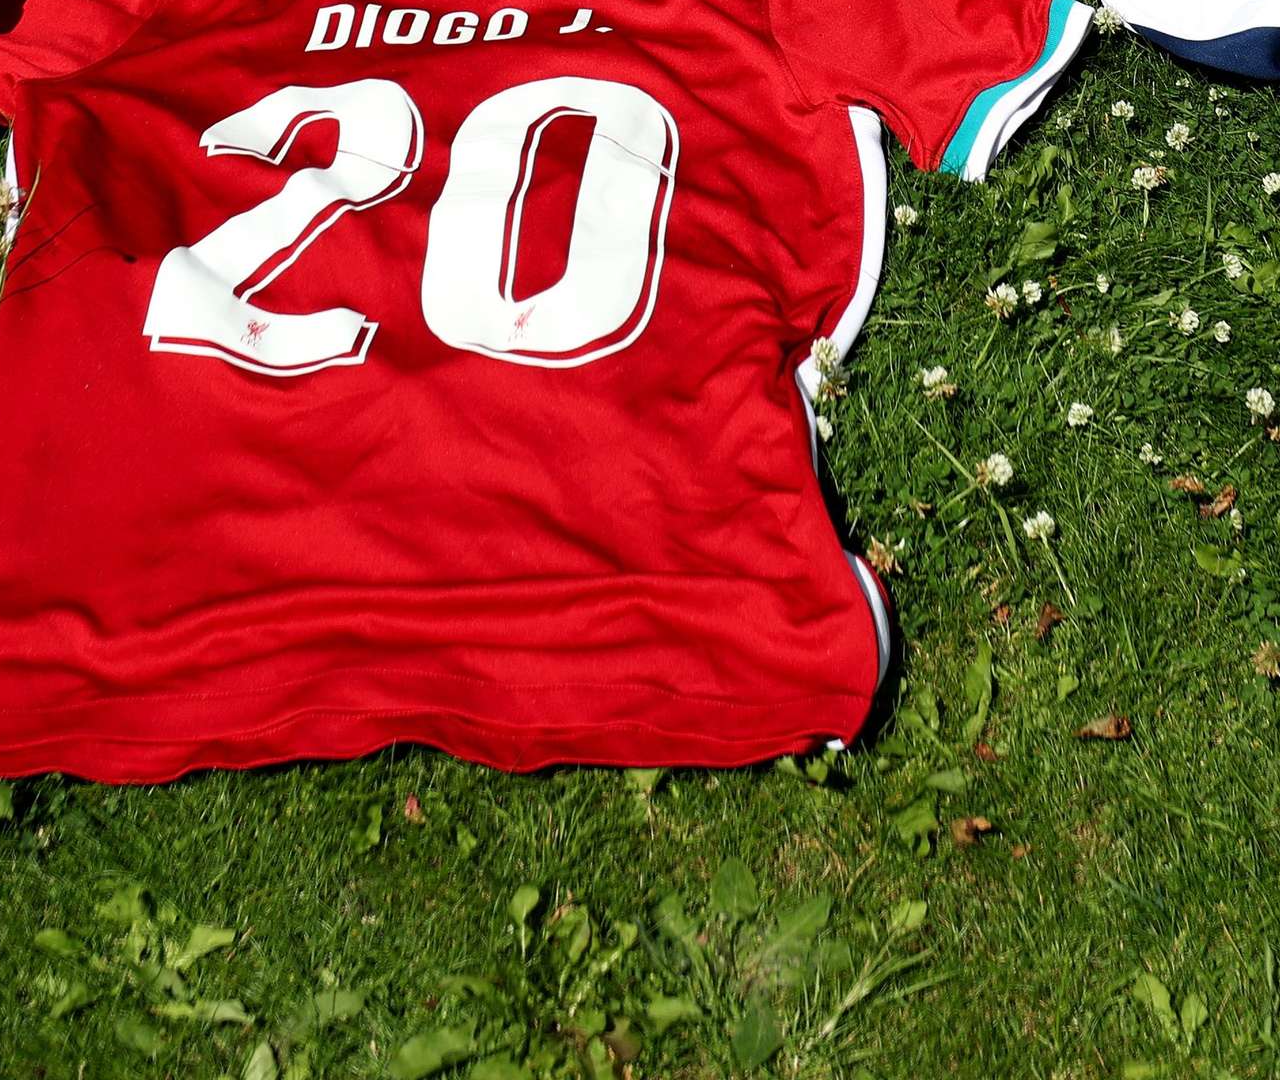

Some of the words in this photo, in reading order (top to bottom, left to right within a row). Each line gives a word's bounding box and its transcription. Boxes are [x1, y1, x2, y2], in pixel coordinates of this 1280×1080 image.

[304, 3, 529, 53] DIOGO
[558, 8, 614, 35] J.
[141, 75, 680, 378] 20
